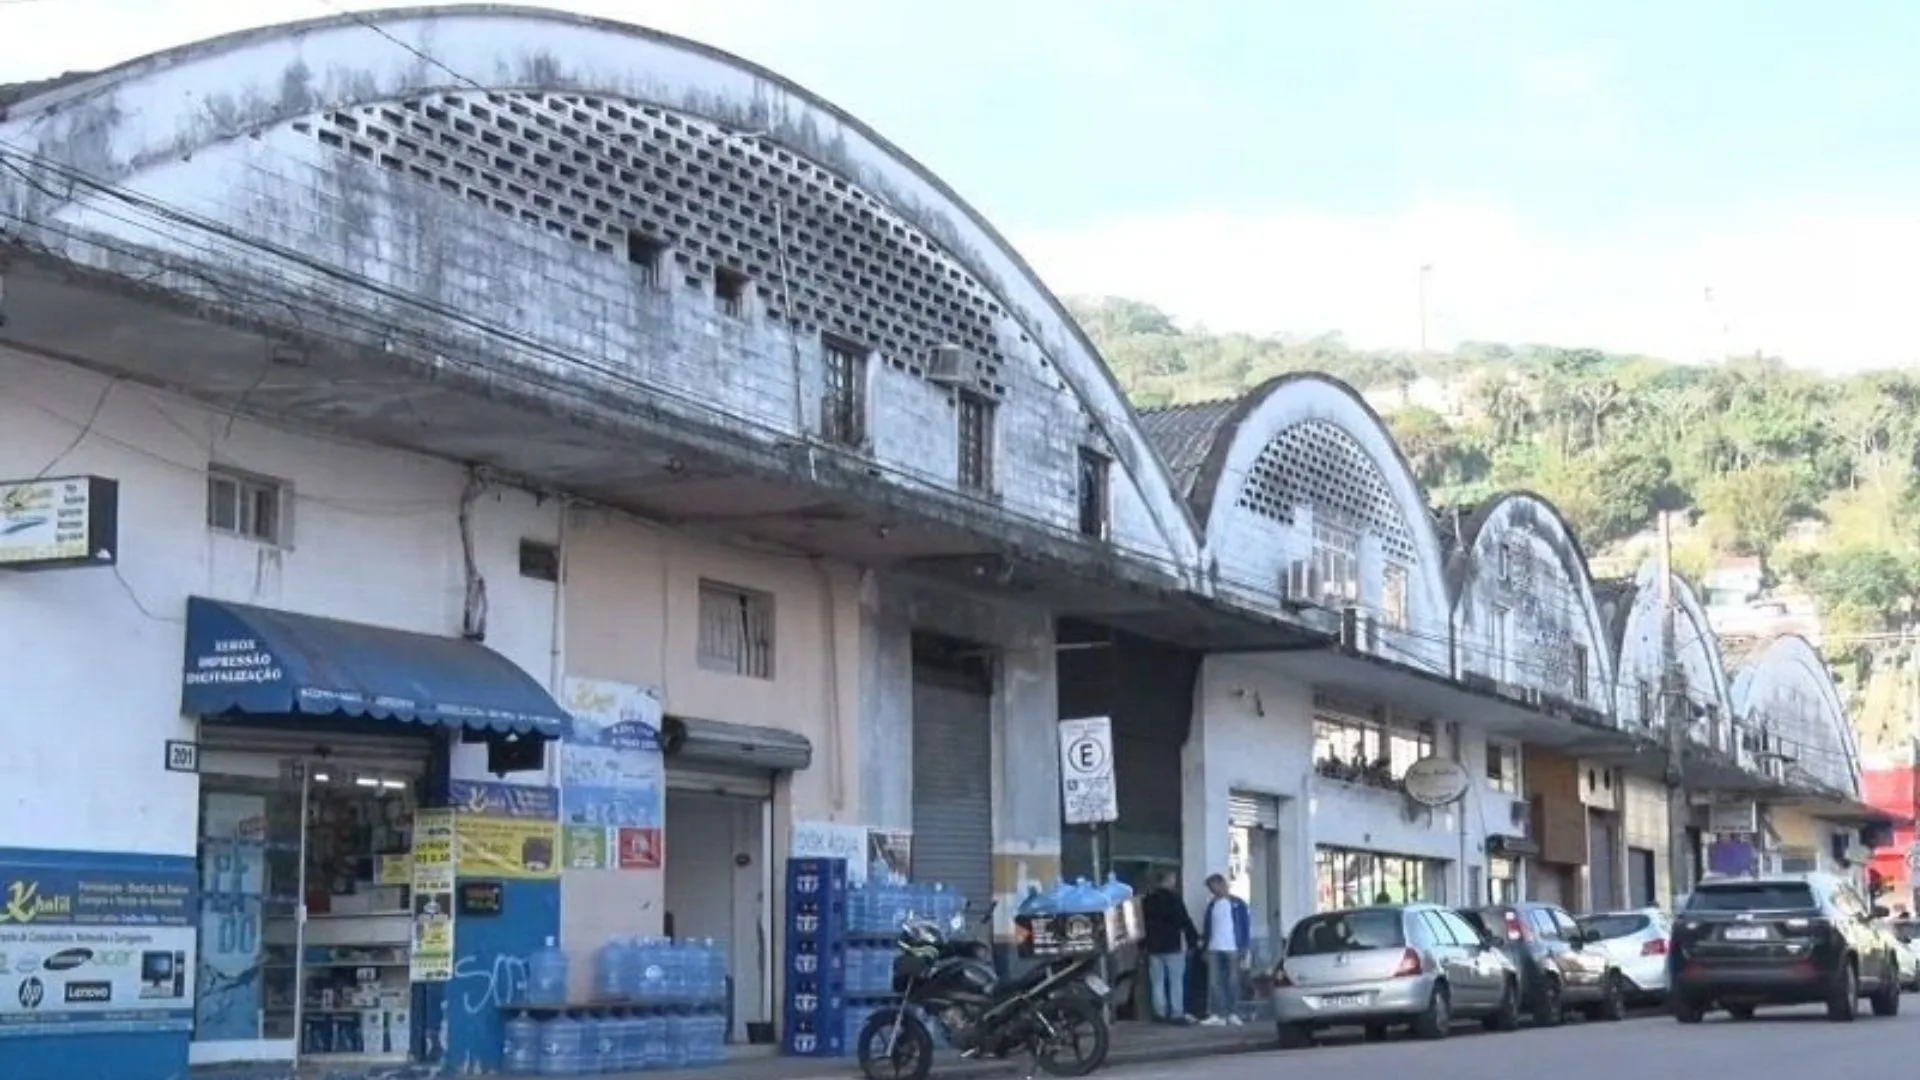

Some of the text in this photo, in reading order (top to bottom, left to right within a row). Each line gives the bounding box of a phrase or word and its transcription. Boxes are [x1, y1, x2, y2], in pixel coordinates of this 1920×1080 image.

[215, 639, 256, 652] XEROX
[186, 667, 282, 685] DIGITALIZAÇÃO
[174, 747, 193, 764] 201
[1080, 743, 1093, 767] E
[68, 986, 109, 999] Lenovo
